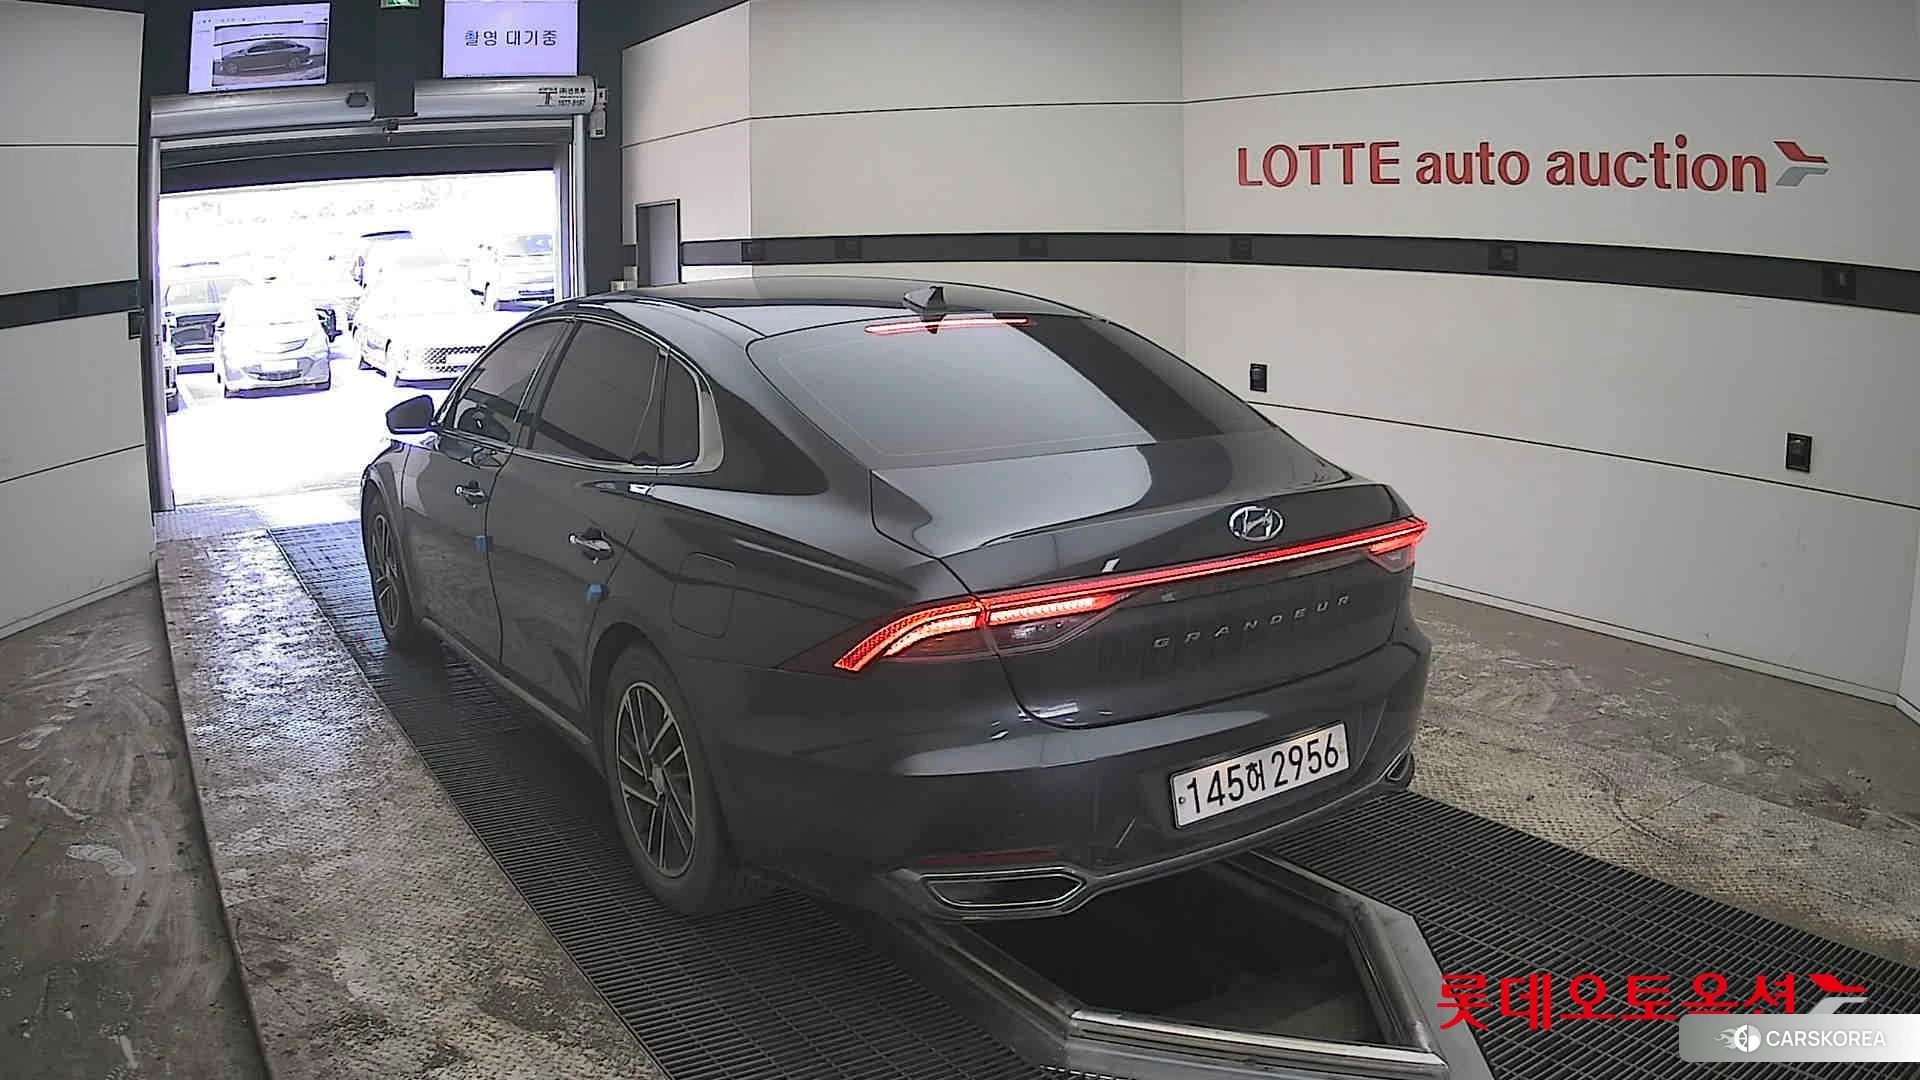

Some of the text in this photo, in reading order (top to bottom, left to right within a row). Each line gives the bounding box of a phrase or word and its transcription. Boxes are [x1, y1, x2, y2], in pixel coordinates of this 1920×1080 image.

[1237, 133, 1768, 194] LOTTE auto auction
[1153, 595, 1351, 649] GRANDEUR
